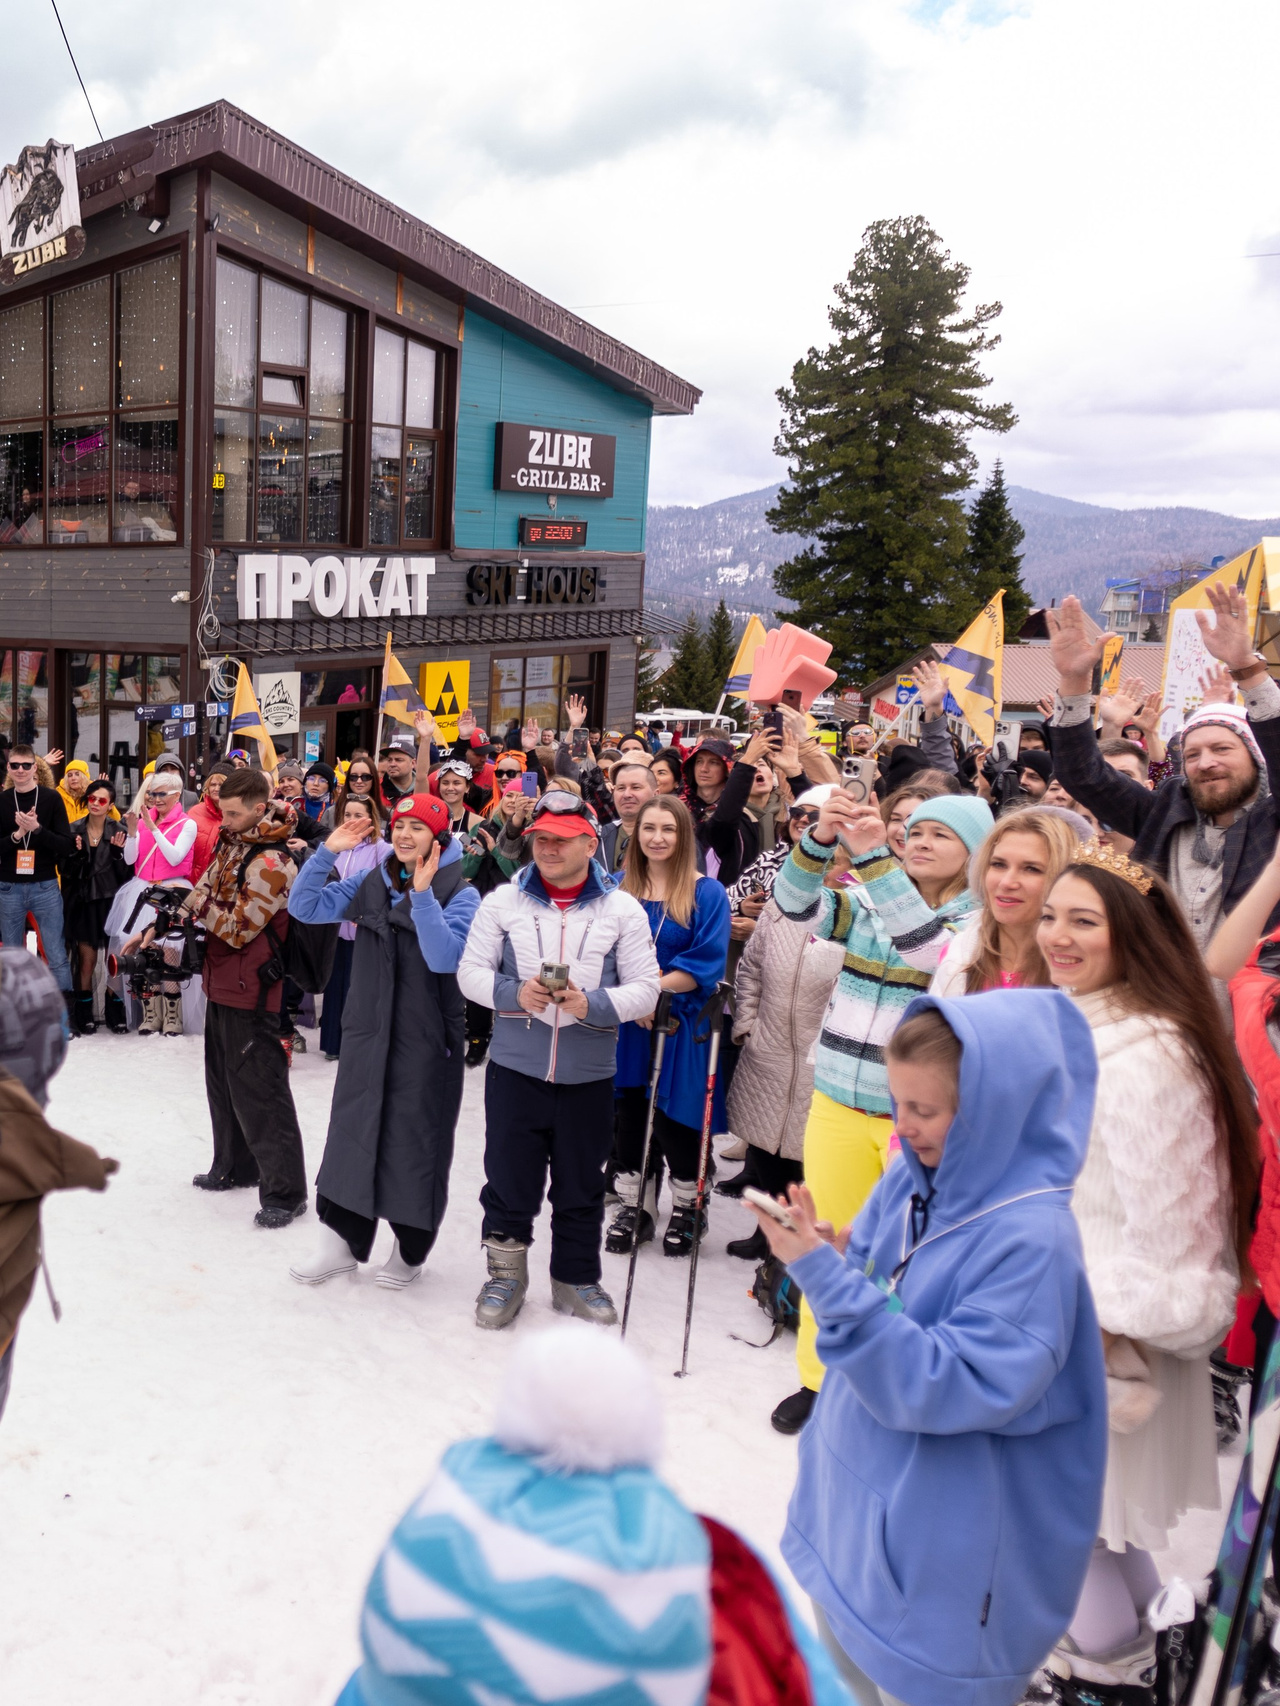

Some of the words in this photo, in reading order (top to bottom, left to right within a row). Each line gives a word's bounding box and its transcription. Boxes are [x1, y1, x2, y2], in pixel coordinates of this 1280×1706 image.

[12, 236, 68, 276] ZUBR
[528, 430, 593, 469] ZUBR
[238, 554, 436, 619] ПРОКАТ
[466, 565, 520, 606] SKI
[526, 566, 607, 605] HOUSE
